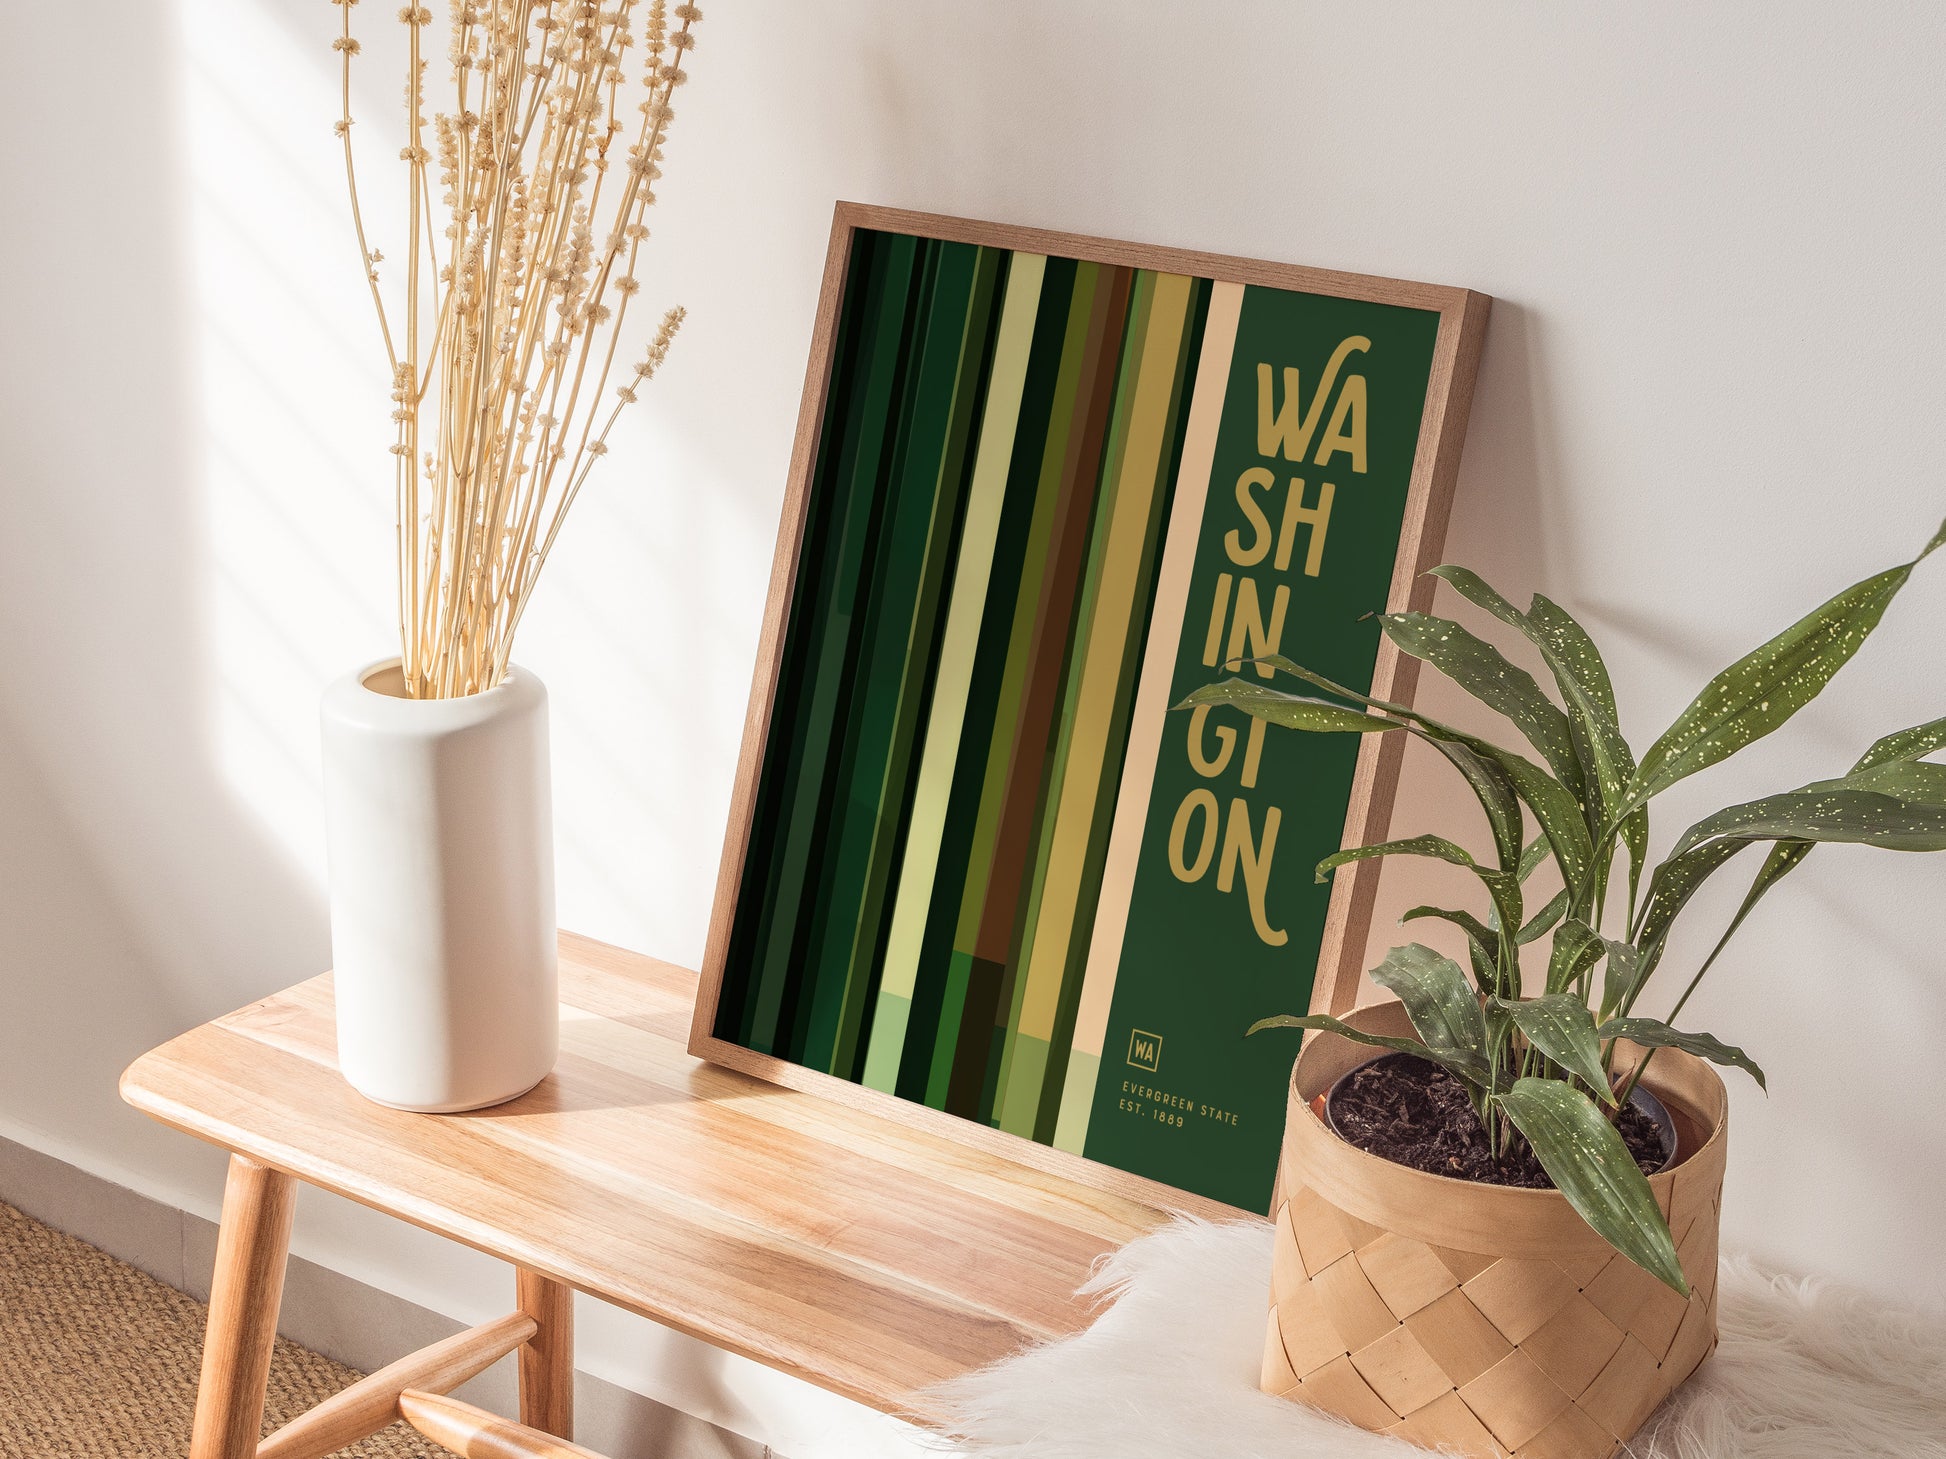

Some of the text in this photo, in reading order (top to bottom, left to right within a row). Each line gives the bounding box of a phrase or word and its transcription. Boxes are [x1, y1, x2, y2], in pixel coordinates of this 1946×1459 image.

[1257, 335, 1371, 474] WA
[1224, 466, 1336, 578] SH
[1202, 572, 1291, 680] IN
[1168, 788, 1289, 947] ON
[1122, 1080, 1239, 1126] EVERGREEN STATE
[1135, 1039, 1154, 1062] WA
[1119, 1098, 1184, 1128] EST. 1889
